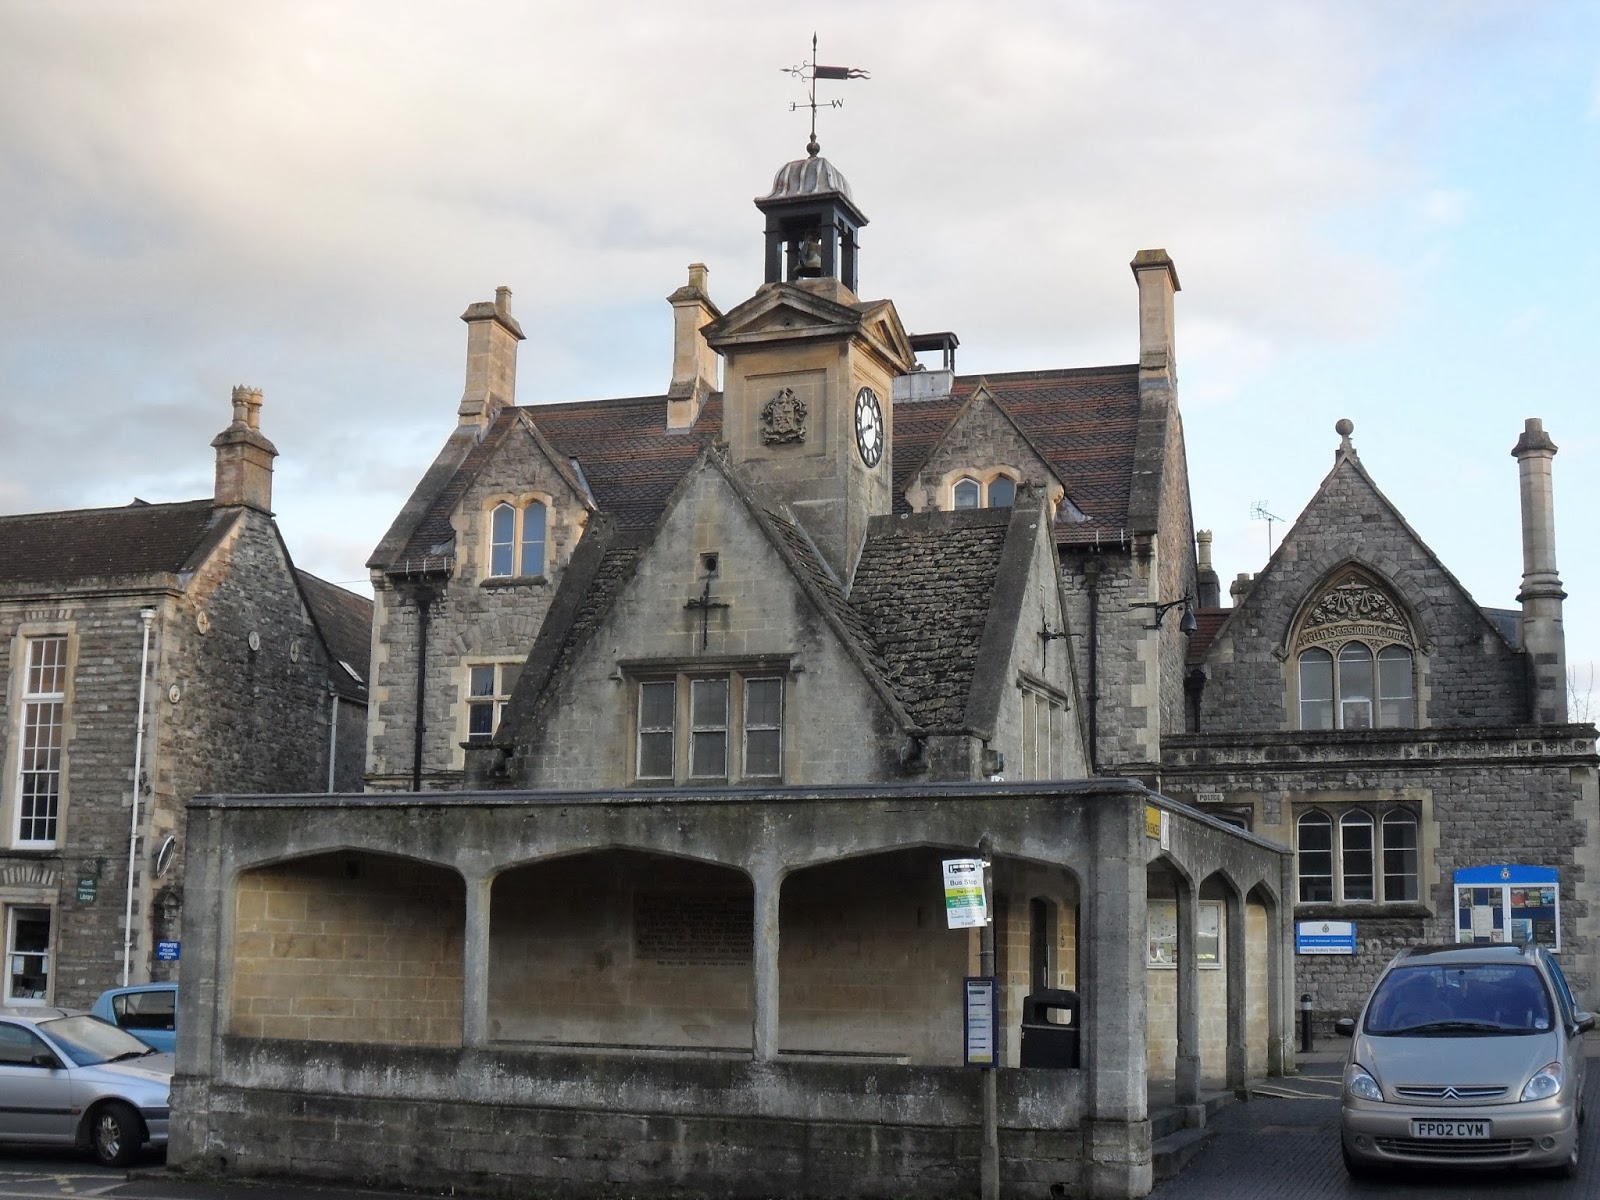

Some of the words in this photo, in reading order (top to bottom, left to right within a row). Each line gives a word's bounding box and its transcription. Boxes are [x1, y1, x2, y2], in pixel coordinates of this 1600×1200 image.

[1328, 625, 1376, 638] Sessional
[79, 893, 94, 902] Library
[1418, 1123, 1454, 1136] FP02
[1457, 1123, 1484, 1136] CVM
